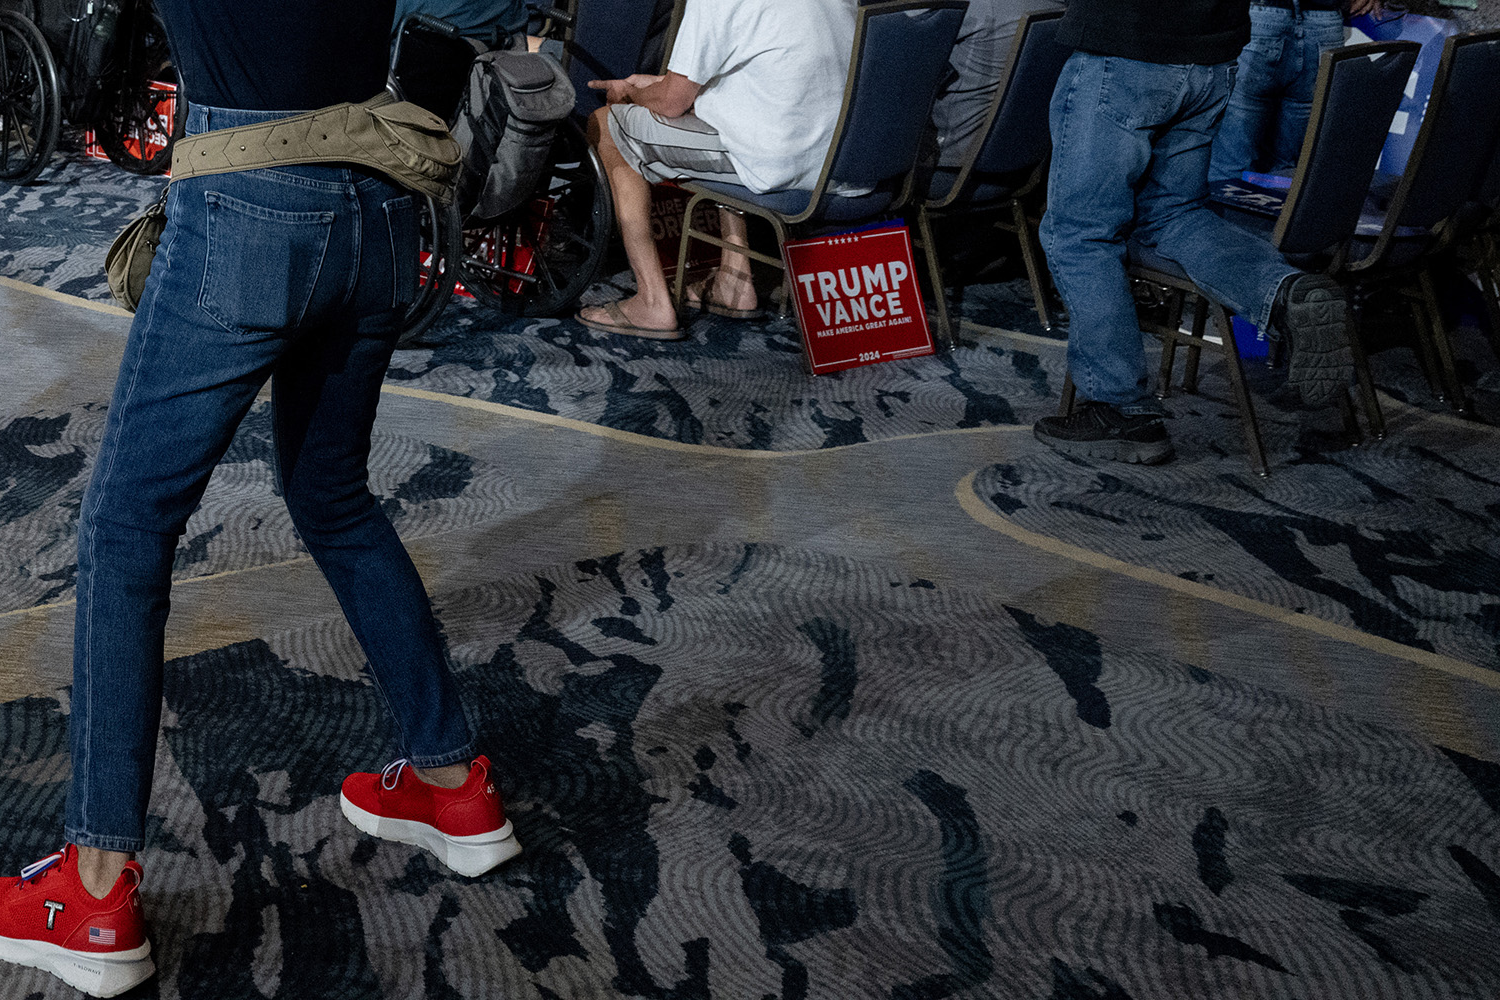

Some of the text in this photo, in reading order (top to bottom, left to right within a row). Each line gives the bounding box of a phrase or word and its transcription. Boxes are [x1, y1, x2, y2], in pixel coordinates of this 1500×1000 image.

[798, 260, 908, 303] TRUMP
[815, 291, 904, 327] VANCE
[817, 328, 834, 338] MAKE
[836, 324, 864, 335] AMERICA
[865, 320, 887, 329] GREAT
[859, 350, 881, 362] 2024
[43, 899, 65, 932] T
